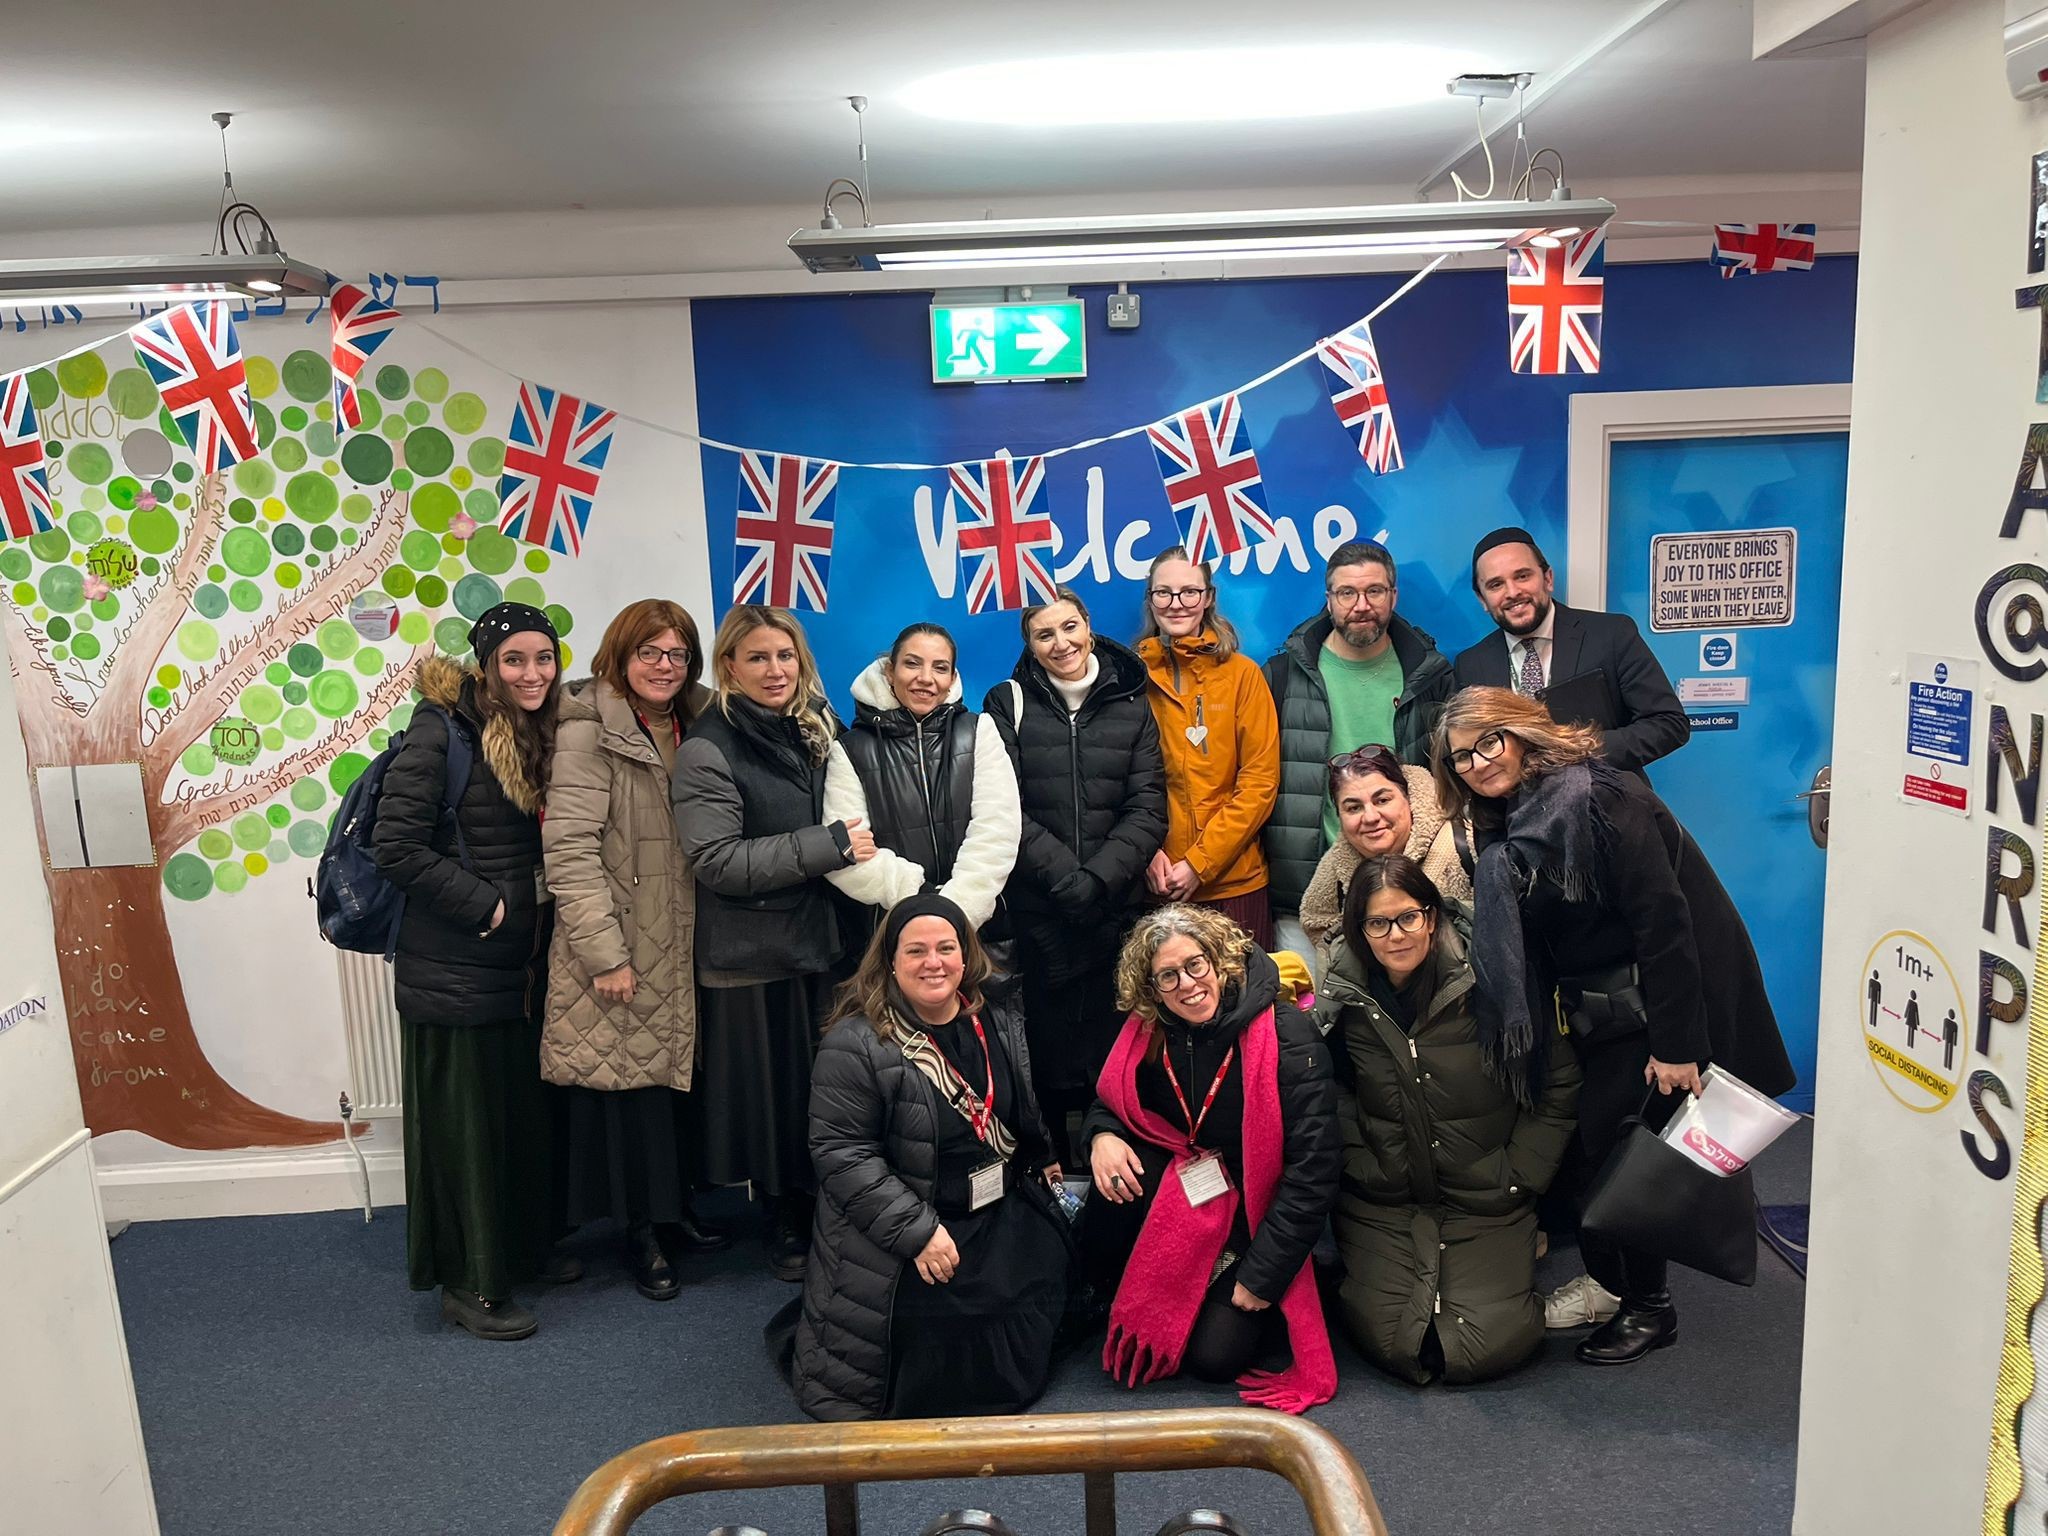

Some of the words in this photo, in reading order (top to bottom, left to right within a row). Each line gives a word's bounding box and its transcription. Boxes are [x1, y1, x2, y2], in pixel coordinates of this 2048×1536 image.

[1668, 542, 1732, 561] EVERYONE
[1734, 539, 1778, 558] BRINGS
[1663, 565, 1685, 582] JOY
[1688, 564, 1703, 582] TO
[1707, 563, 1736, 580] THIS
[1739, 560, 1783, 578] OFFICE
[1661, 590, 1688, 604] SOME
[1691, 588, 1721, 602] WHEN
[1724, 587, 1750, 601] THEY
[1752, 585, 1787, 600] ENTER,
[1661, 606, 1688, 621] SOME
[1691, 604, 1721, 619] WHEN
[1724, 603, 1750, 618] THEY
[1752, 602, 1784, 616] LEAVE
[65, 651, 116, 698] Know
[131, 576, 168, 627] where
[163, 548, 187, 585] you
[183, 666, 212, 695] look
[252, 614, 275, 648] jug
[300, 553, 338, 597] what
[30, 661, 88, 718] yourself
[1918, 684, 1934, 698] Fire
[1935, 687, 1963, 702] Action
[1712, 716, 1734, 725] Office
[177, 768, 233, 814] Greet
[367, 662, 401, 704] smile
[211, 744, 256, 761] Kindness
[1895, 946, 1934, 982] 1m+
[1868, 1040, 1897, 1066] SOCIAL
[1898, 1057, 1949, 1096] DISTANCING
